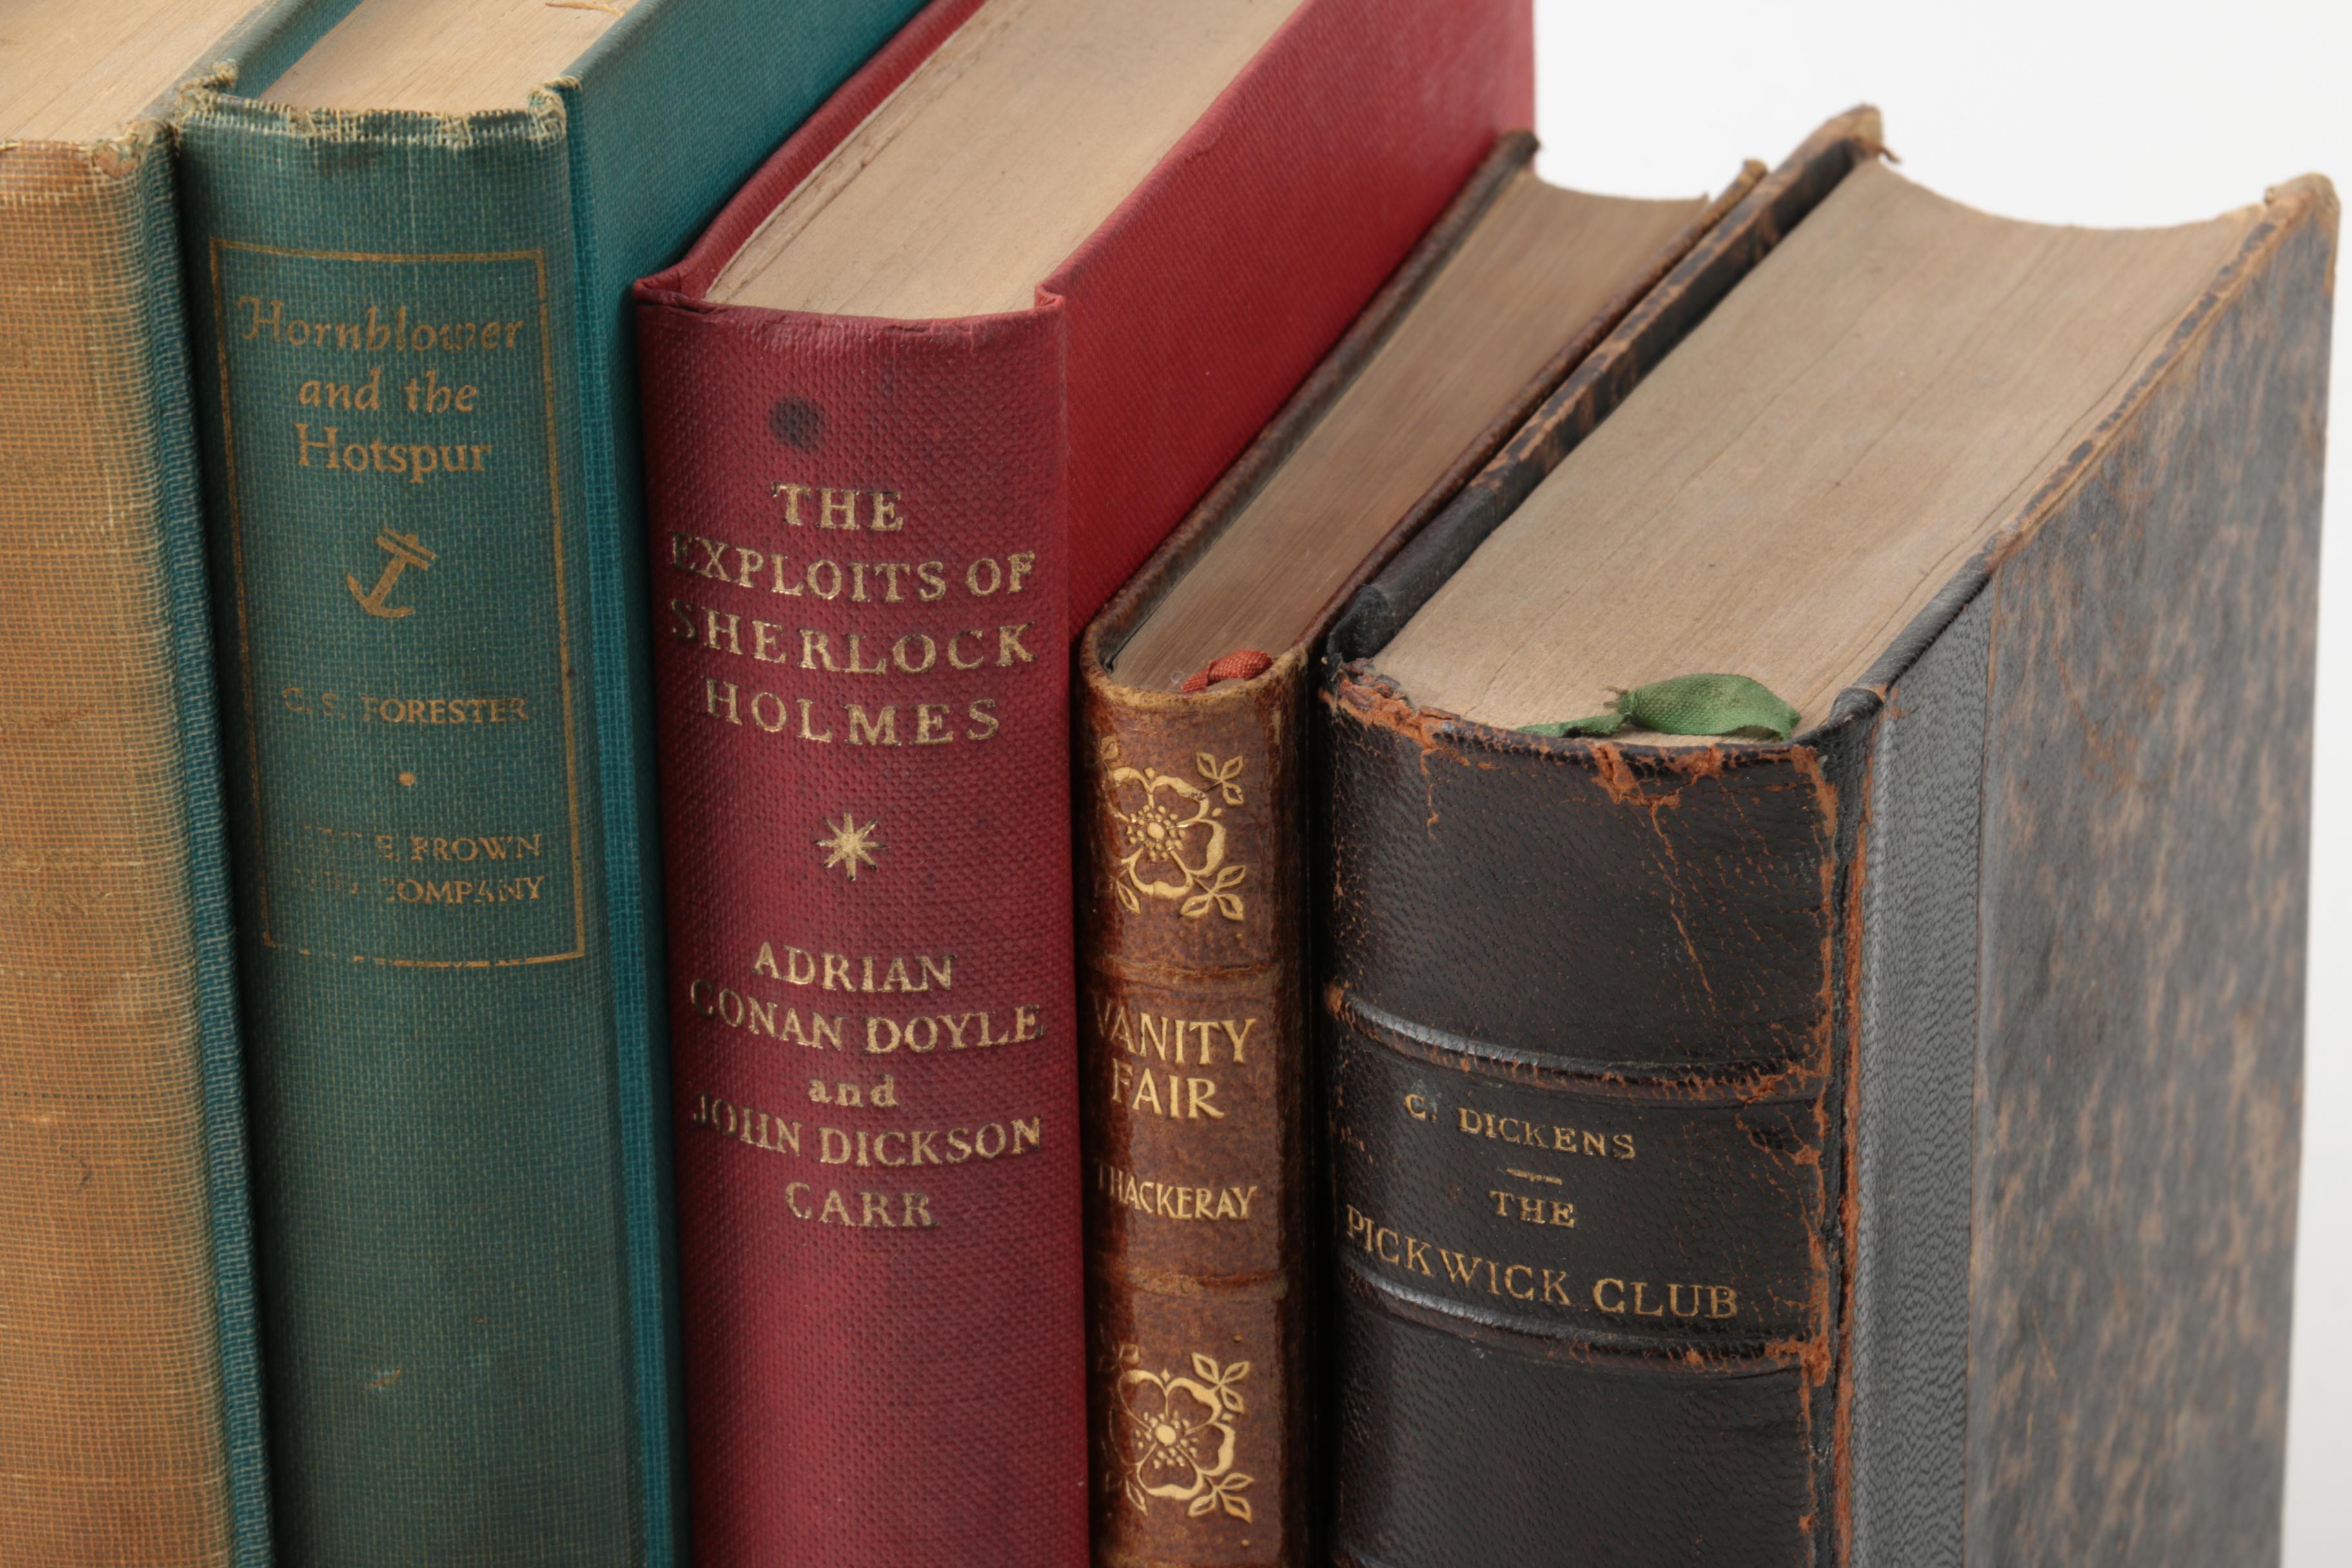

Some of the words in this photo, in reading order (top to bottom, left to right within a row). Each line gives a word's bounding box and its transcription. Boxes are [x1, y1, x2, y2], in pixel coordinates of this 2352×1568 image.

[238, 296, 524, 351] Hornblower
[298, 367, 383, 411] and
[404, 369, 478, 413] the
[293, 422, 493, 484] Hotspur
[771, 482, 905, 531] THE
[671, 530, 948, 602] EXPLOITS
[965, 551, 1036, 597] OF
[671, 598, 1037, 675] SHERLOCK
[360, 696, 530, 725] FORESTER
[703, 676, 1001, 746] HOLMES
[752, 941, 957, 993] ADRIAN
[690, 979, 846, 1050] CONAN
[863, 1003, 1044, 1054] DOYLE
[1093, 995, 1257, 1065] VANITY
[808, 1073, 899, 1108] and
[1111, 1057, 1225, 1119] FAIR
[692, 1092, 803, 1156] JOHN
[817, 1115, 1043, 1166] DICKSON
[1404, 1093, 1437, 1123] C.
[1458, 1106, 1636, 1159] DICKENS
[785, 1181, 939, 1228] CARR
[1489, 1190, 1575, 1228] THE
[1346, 1204, 1571, 1307] PICKWICK
[1592, 1278, 1738, 1319] CLUB
